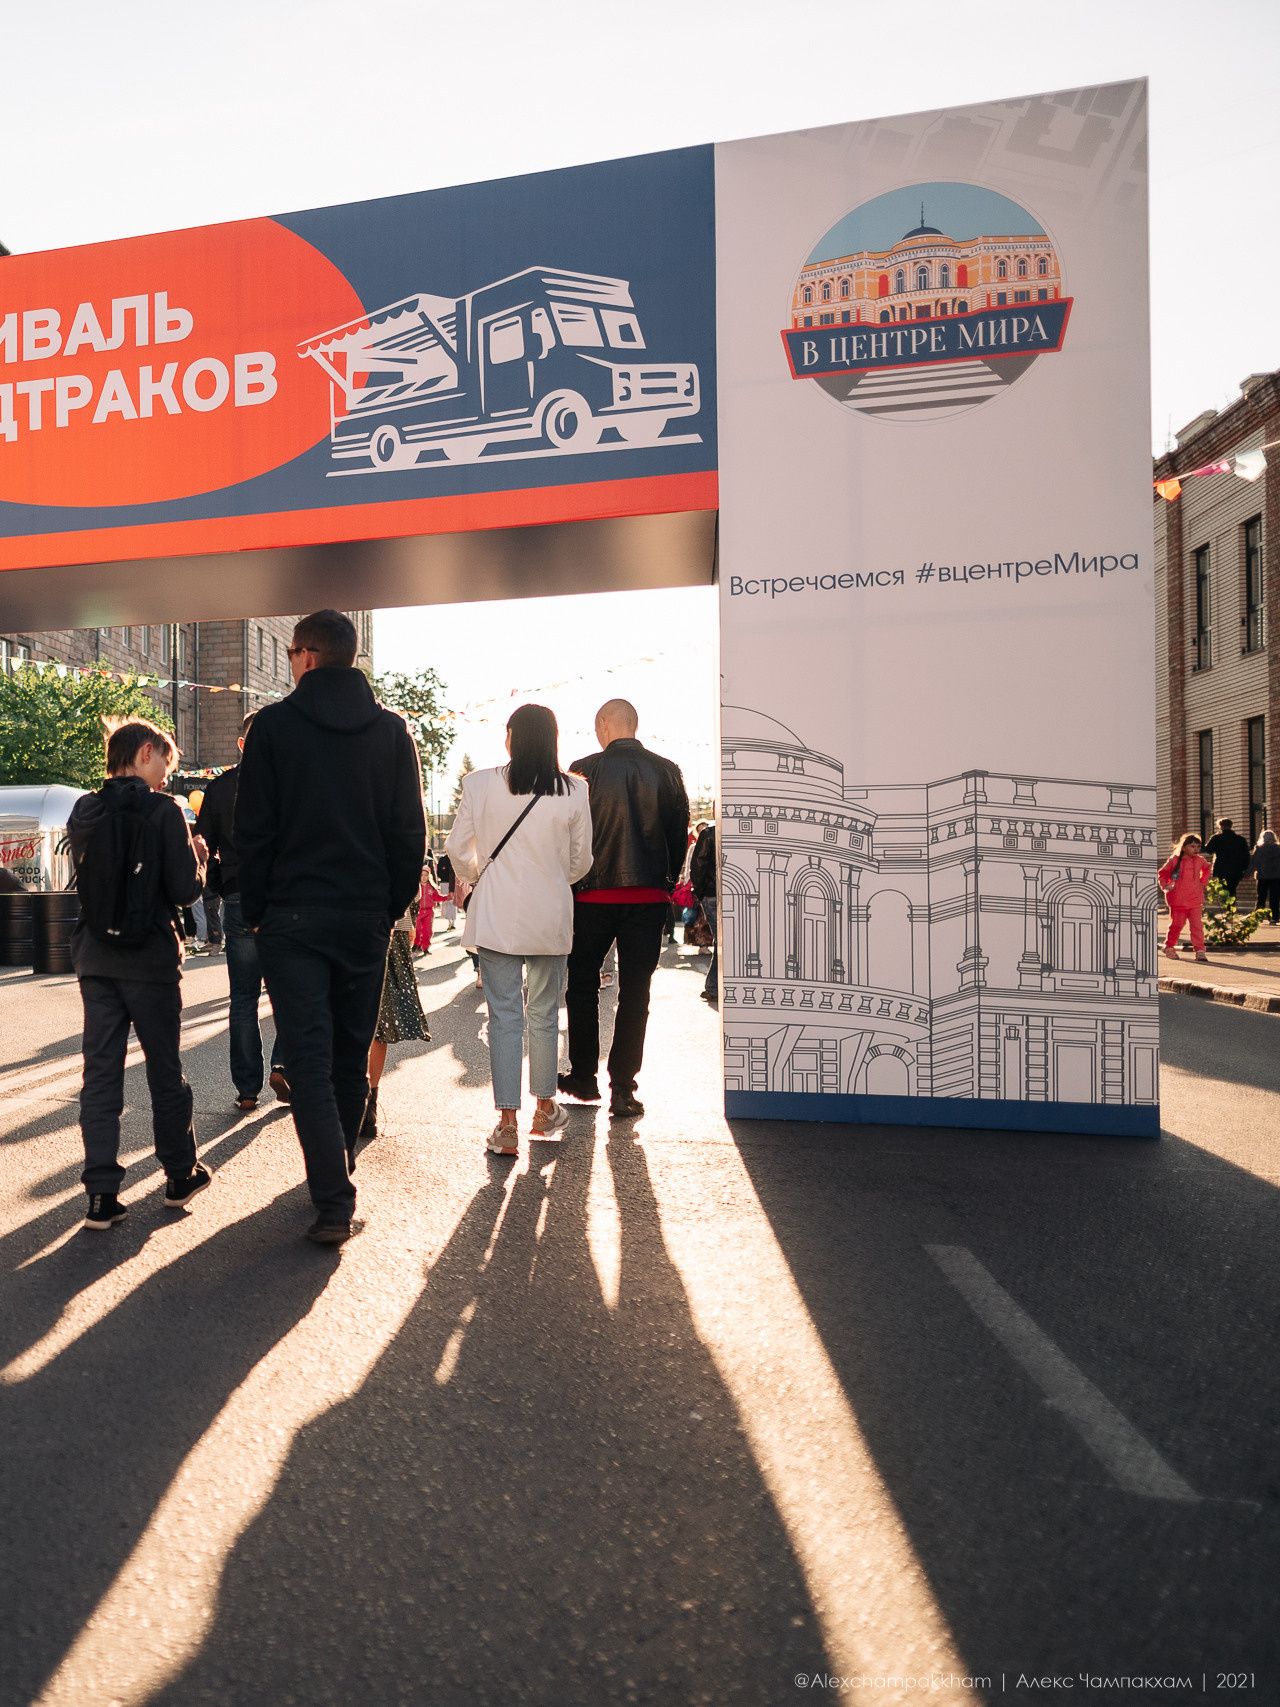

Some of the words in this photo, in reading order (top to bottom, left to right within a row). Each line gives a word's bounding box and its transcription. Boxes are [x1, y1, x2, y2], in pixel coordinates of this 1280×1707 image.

[802, 341, 819, 366] В
[829, 326, 947, 366] ЦЕНТРЕ
[957, 315, 1050, 350] МИРА
[730, 567, 905, 599] Встречаемся
[915, 551, 1139, 585] #вцентреМира
[12, 867, 40, 875] FOOD
[19, 875, 46, 884] RUCK
